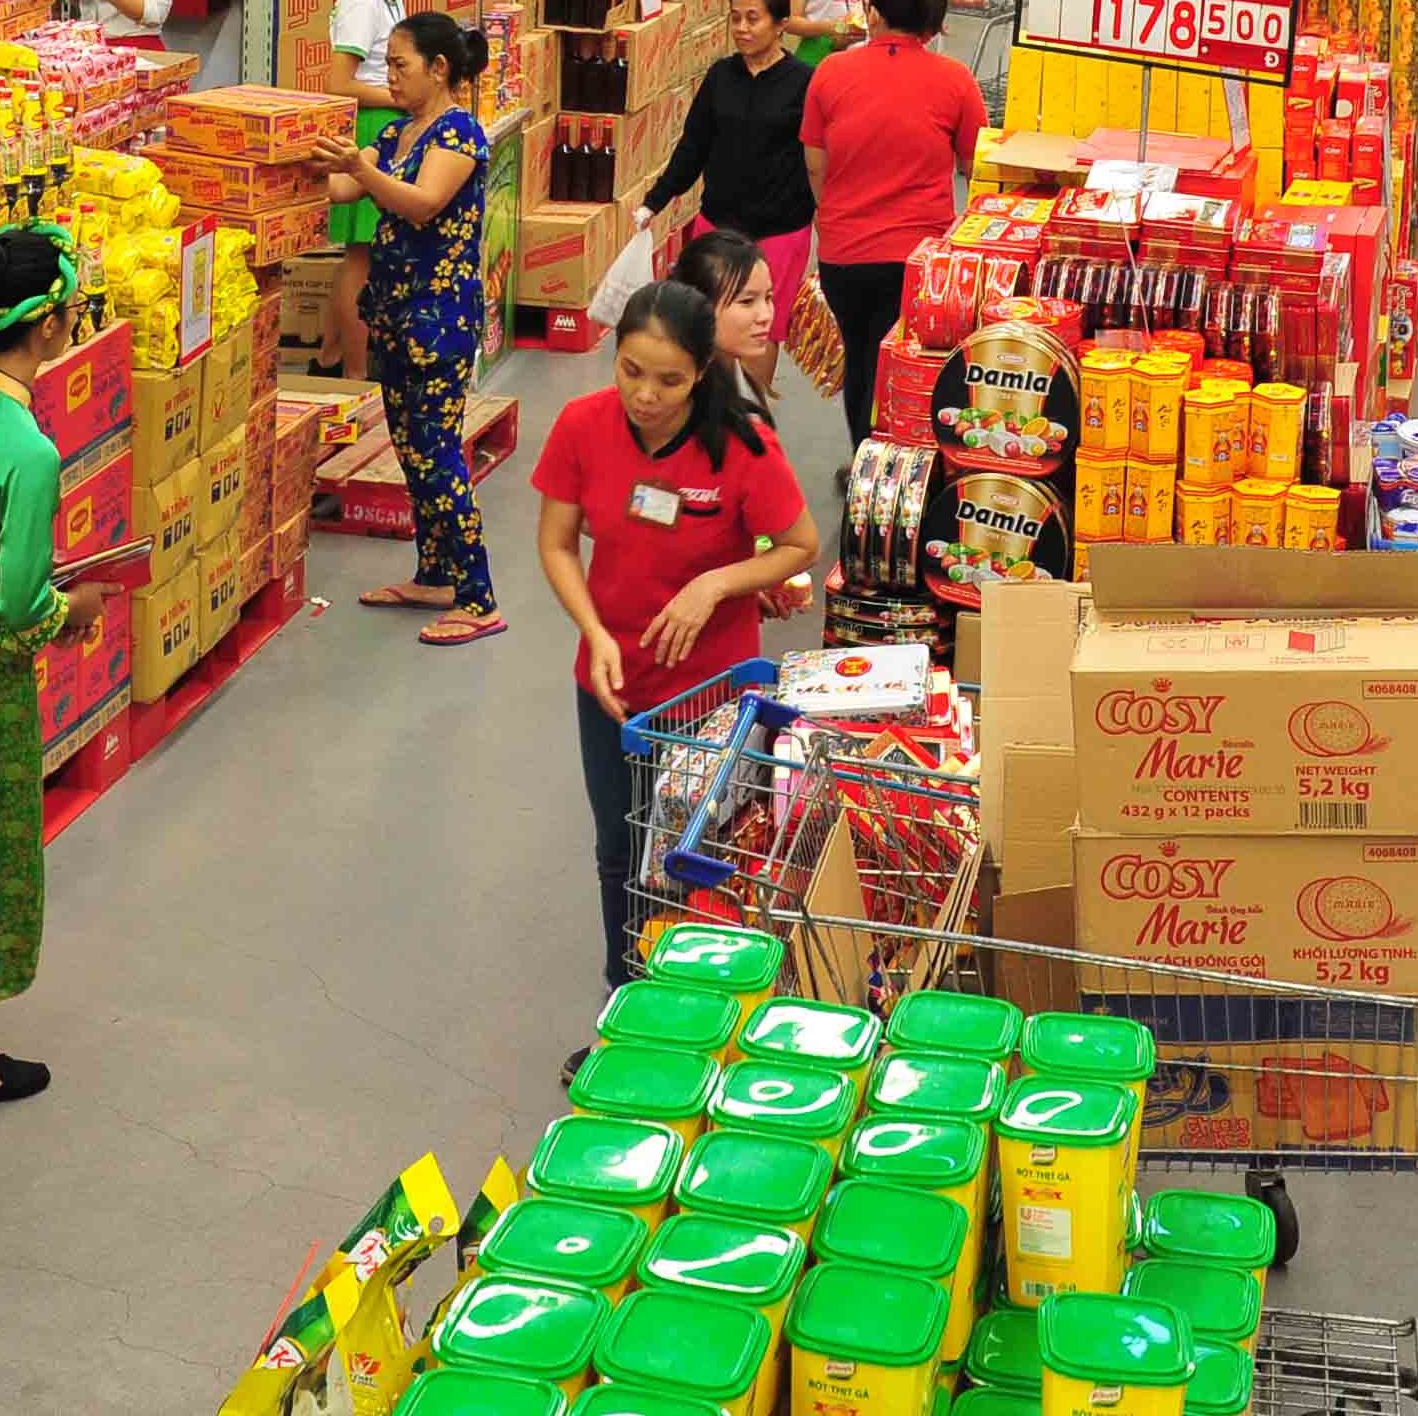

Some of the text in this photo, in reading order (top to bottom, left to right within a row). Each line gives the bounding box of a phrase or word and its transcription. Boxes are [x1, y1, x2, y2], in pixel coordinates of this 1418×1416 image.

[967, 364, 1052, 394] Damla
[957, 501, 1043, 539] Damla
[1096, 690, 1225, 734] COSY
[1135, 736, 1244, 782] Marie
[1295, 765, 1378, 776] NET WEIGHT
[1163, 789, 1250, 803] CONTENTS
[1299, 779, 1334, 797] 5,2
[1340, 777, 1371, 800] kg
[1121, 804, 1251, 822] 432 g x 12 packs
[1100, 854, 1236, 900] COSY
[1136, 902, 1247, 947] Marie
[1293, 945, 1327, 959] KHỐI
[1330, 946, 1378, 962] LƯỢNG
[1317, 961, 1390, 984] 5,2 kg
